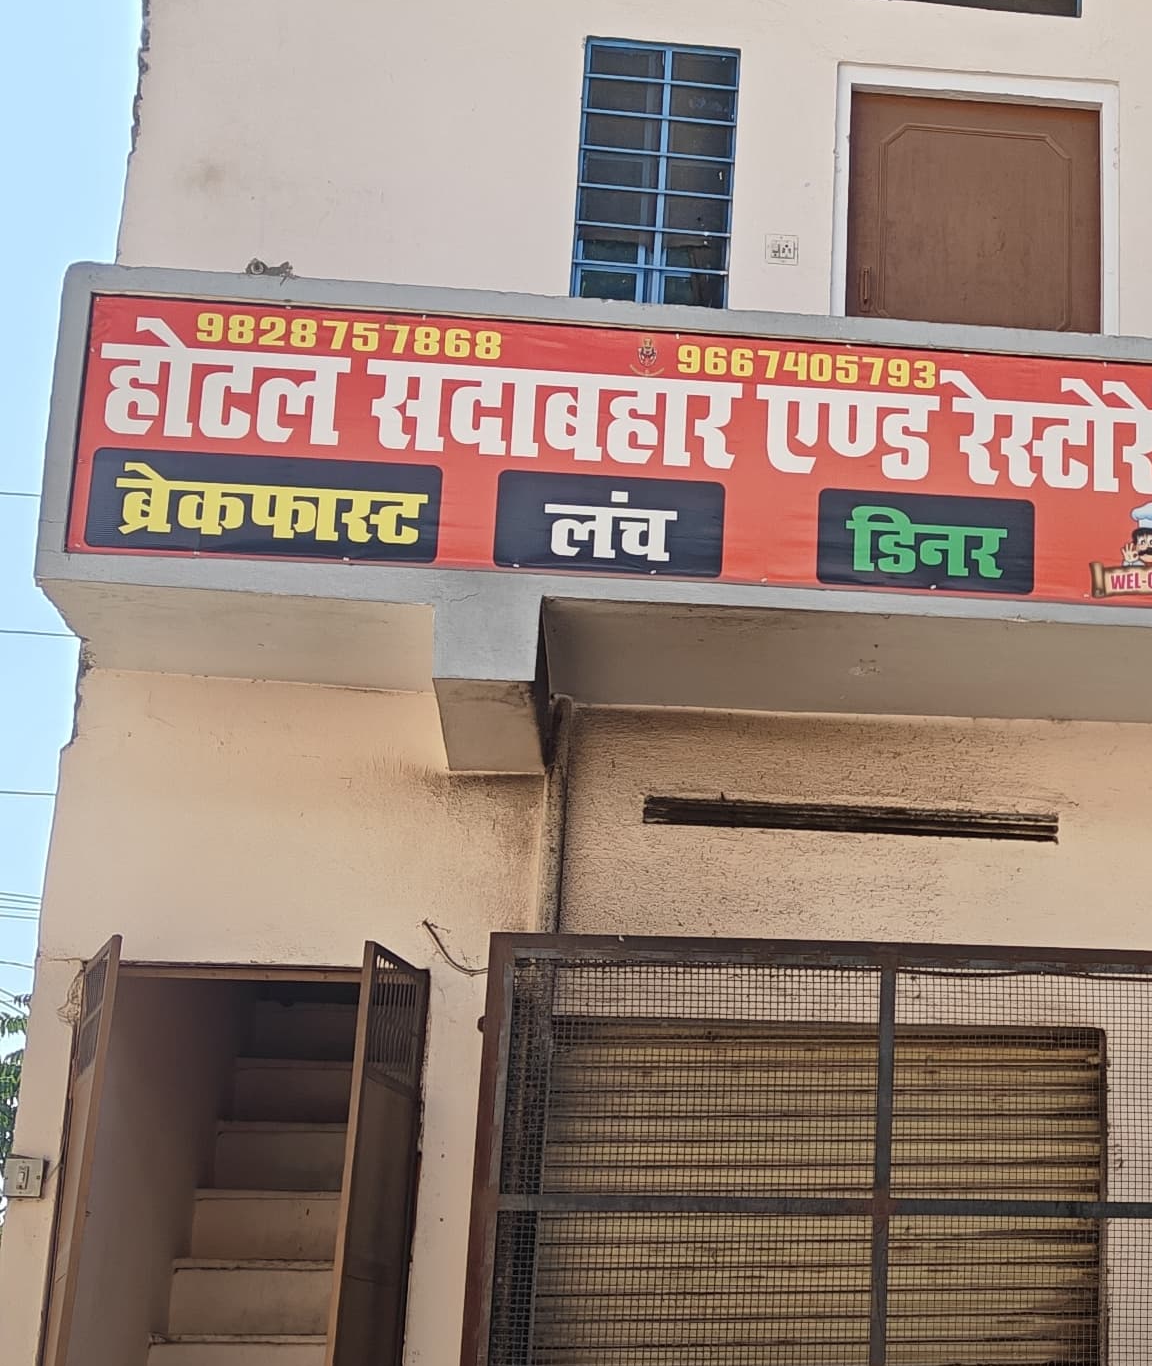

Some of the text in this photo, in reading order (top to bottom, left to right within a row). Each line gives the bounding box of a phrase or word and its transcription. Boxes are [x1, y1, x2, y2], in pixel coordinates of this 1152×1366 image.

[196, 311, 502, 361] 9828757868
[677, 344, 937, 389] 9667405793
[101, 316, 352, 447] होटल
[366, 357, 742, 471] सदाबहार
[756, 384, 941, 481] एण्ड
[116, 461, 429, 546] ब्रेकफास्ट
[544, 490, 678, 562] लंच
[845, 506, 1008, 579] डिनर
